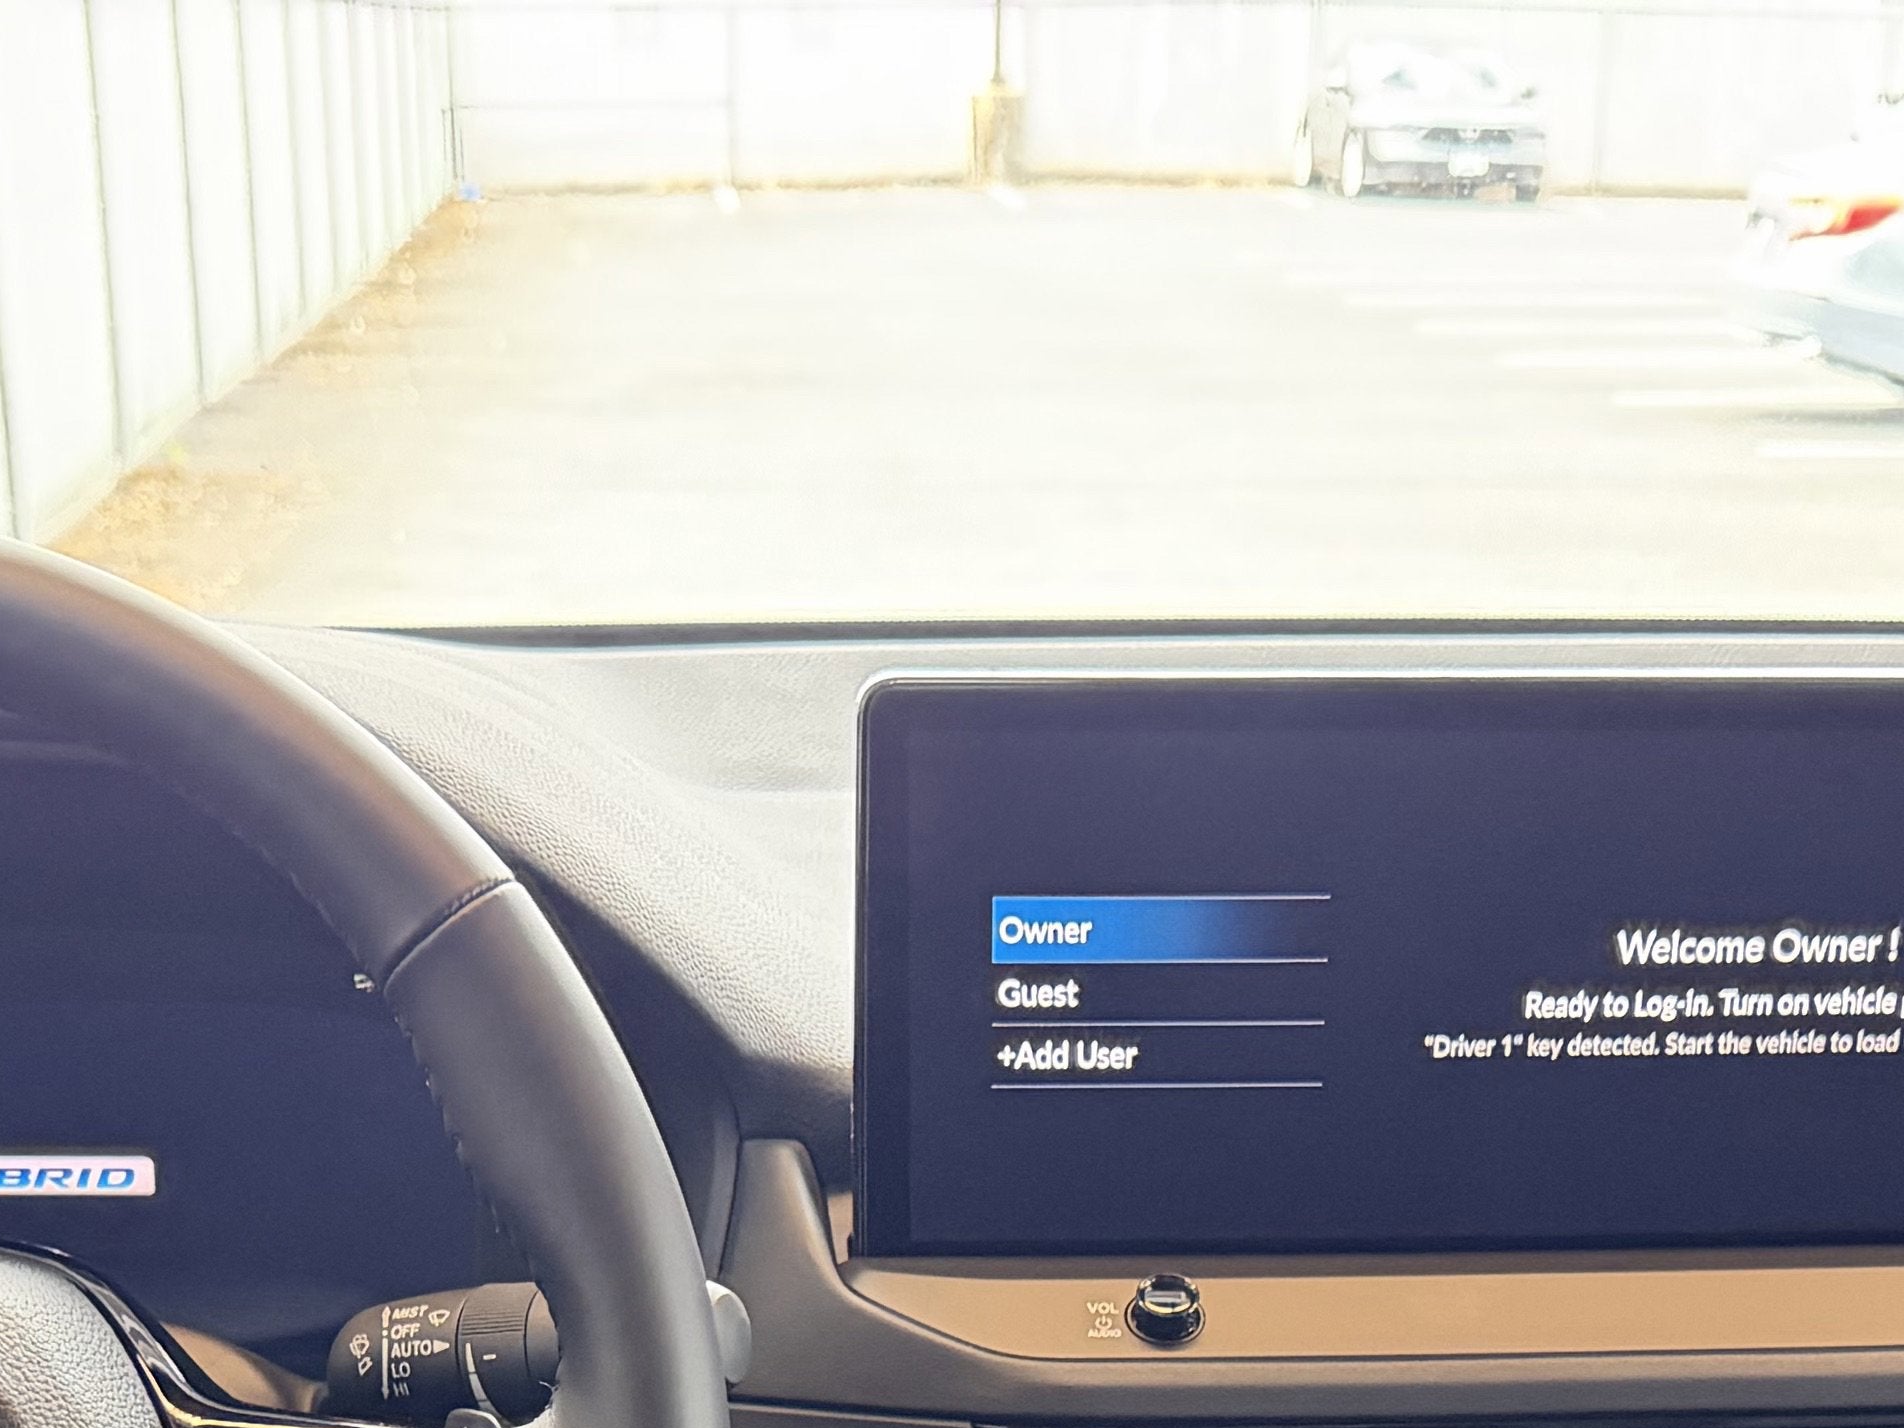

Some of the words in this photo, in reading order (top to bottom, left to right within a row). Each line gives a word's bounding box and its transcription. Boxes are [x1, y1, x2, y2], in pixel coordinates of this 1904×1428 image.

[999, 915, 1093, 944] Owner
[1616, 928, 1766, 966] Welcome
[1772, 927, 1884, 964] Owner
[997, 977, 1080, 1008] Guest
[1524, 988, 1598, 1023] Ready
[1602, 990, 1629, 1018] to
[1718, 987, 1774, 1017] Turn
[1777, 993, 1810, 1017] on
[1813, 985, 1898, 1016] vehicle
[997, 1039, 1070, 1071] +Add
[1076, 1039, 1139, 1070] User
[1424, 1033, 1496, 1059] "Driver
[1527, 1032, 1564, 1061] key
[1567, 1032, 1660, 1057] detected.
[1664, 1031, 1715, 1056] Start
[1718, 1030, 1753, 1055] the
[1756, 1029, 1826, 1055] vehicle
[1830, 1031, 1854, 1054] to
[1856, 1027, 1902, 1054] load
[1086, 1301, 1120, 1315] VOL
[390, 1323, 421, 1340] OFF
[391, 1339, 432, 1359] AUTO
[391, 1361, 411, 1379] LO
[392, 1382, 410, 1398] HI
